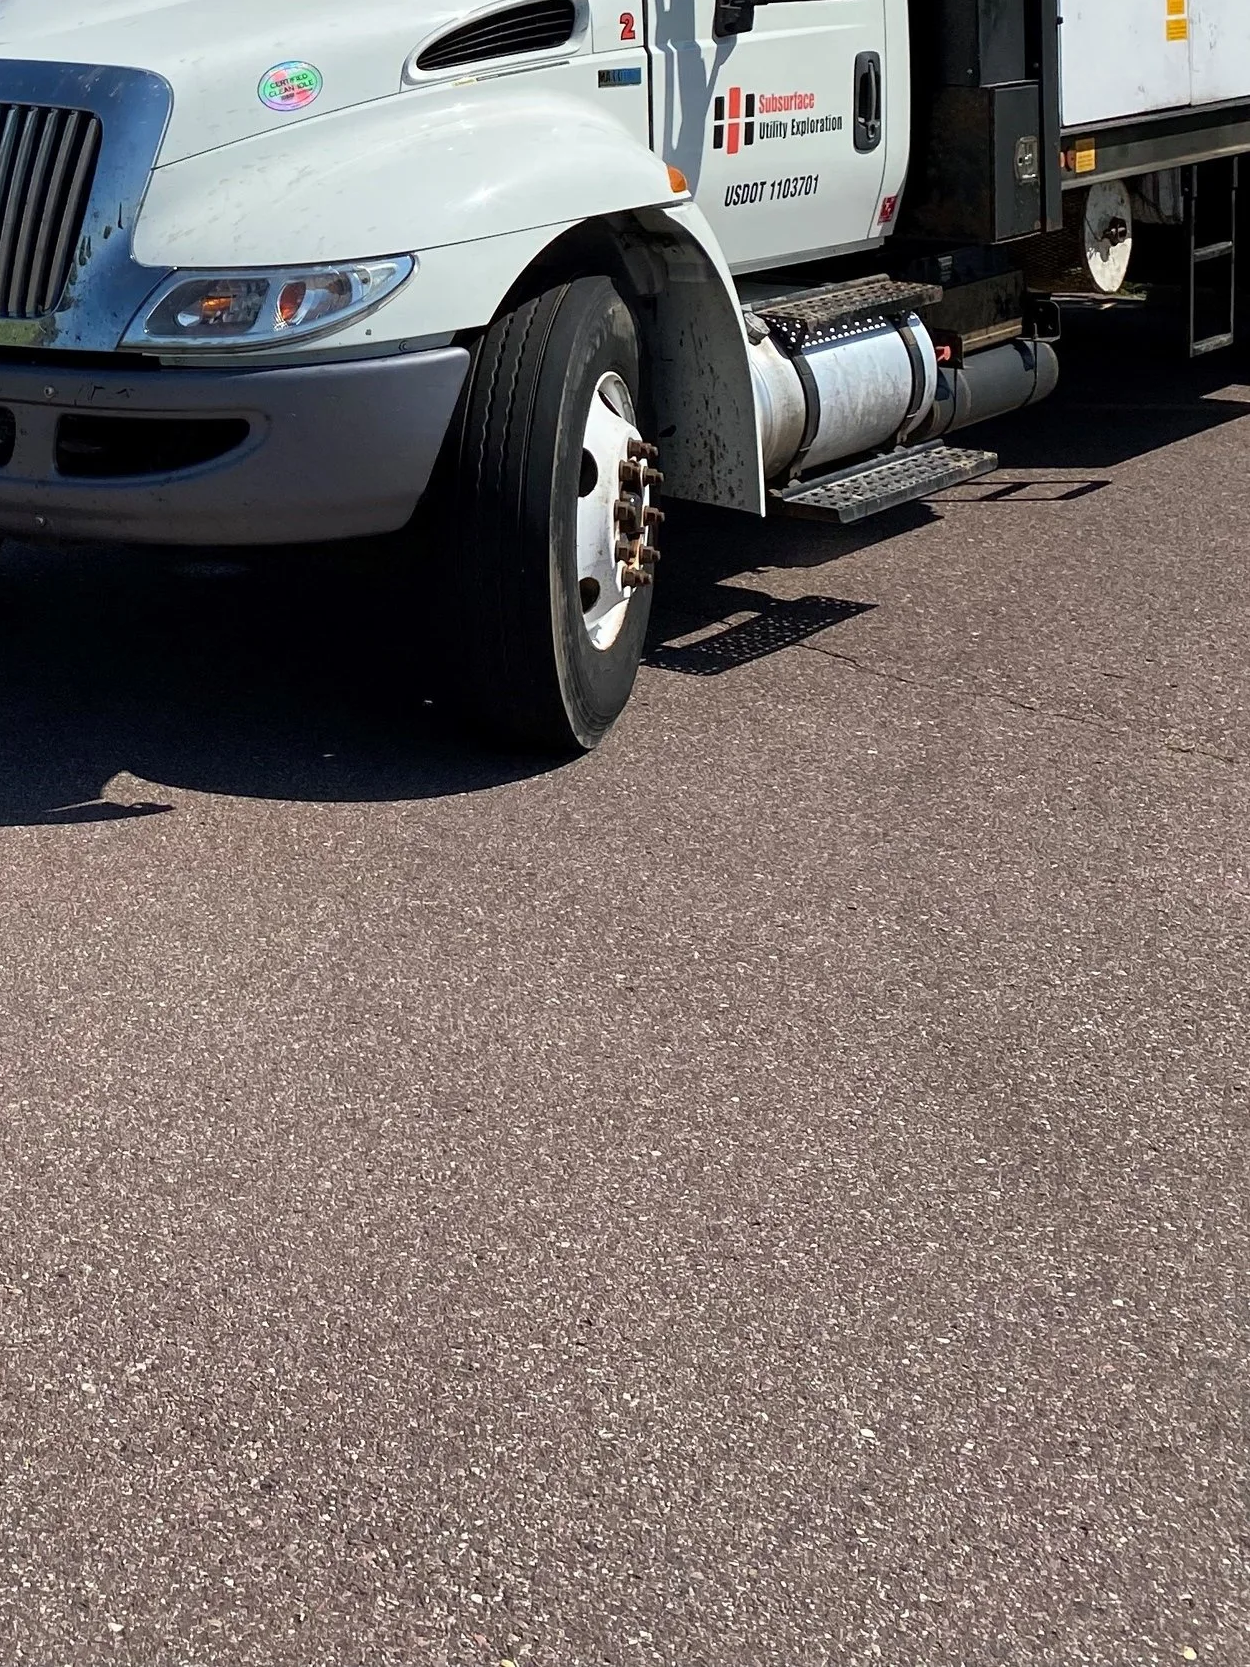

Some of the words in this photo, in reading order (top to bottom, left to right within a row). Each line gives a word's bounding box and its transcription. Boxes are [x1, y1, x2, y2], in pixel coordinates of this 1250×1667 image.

[619, 12, 636, 41] 2
[269, 85, 294, 98] CLEAN
[758, 91, 815, 114] Subsurface
[759, 120, 789, 140] Utility
[791, 114, 843, 137] Exploration
[724, 181, 767, 207] USDOT
[770, 174, 819, 201] 1103701
